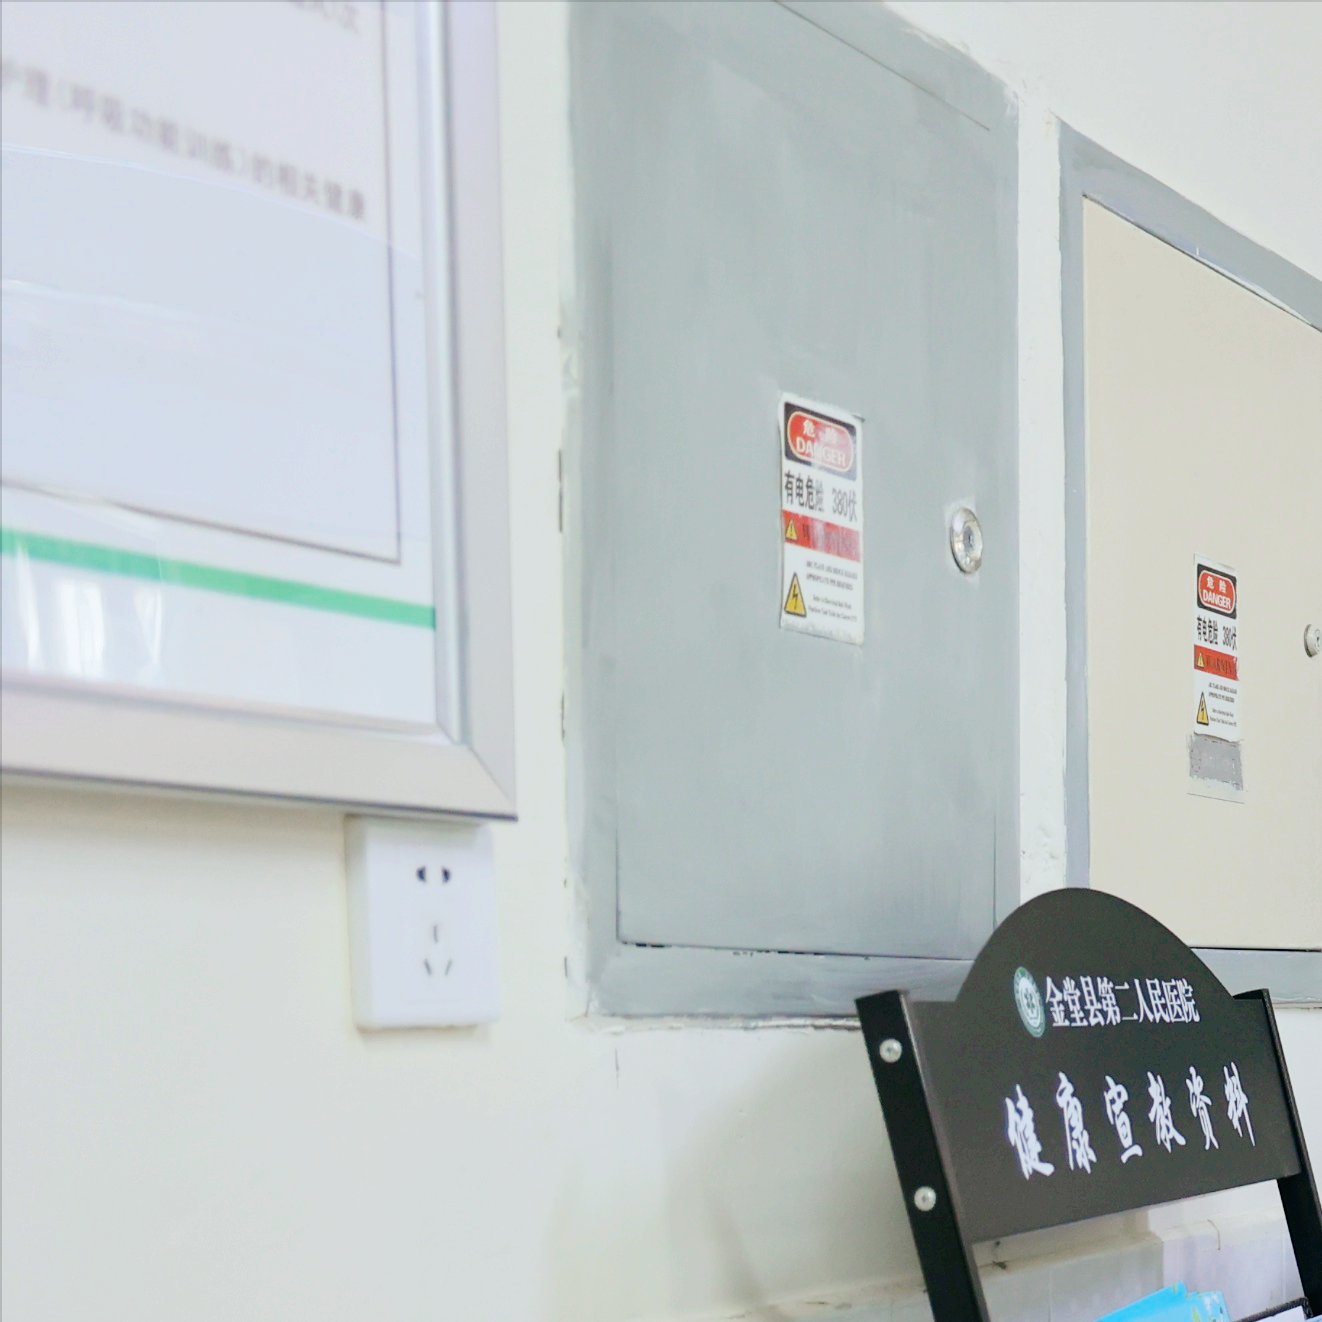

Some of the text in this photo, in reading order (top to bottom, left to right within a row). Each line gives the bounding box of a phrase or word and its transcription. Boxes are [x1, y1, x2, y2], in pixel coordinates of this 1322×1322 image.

[796, 435, 846, 468] DANGER
[784, 471, 858, 522] 有电危险 380伏
[1202, 589, 1232, 609] DANGER
[1206, 575, 1227, 594] 危险
[1196, 615, 1219, 646] 有电危险
[1045, 975, 1200, 1027] 金堂县第二人民医院
[1005, 1061, 1256, 1180] 健康宣教资料
